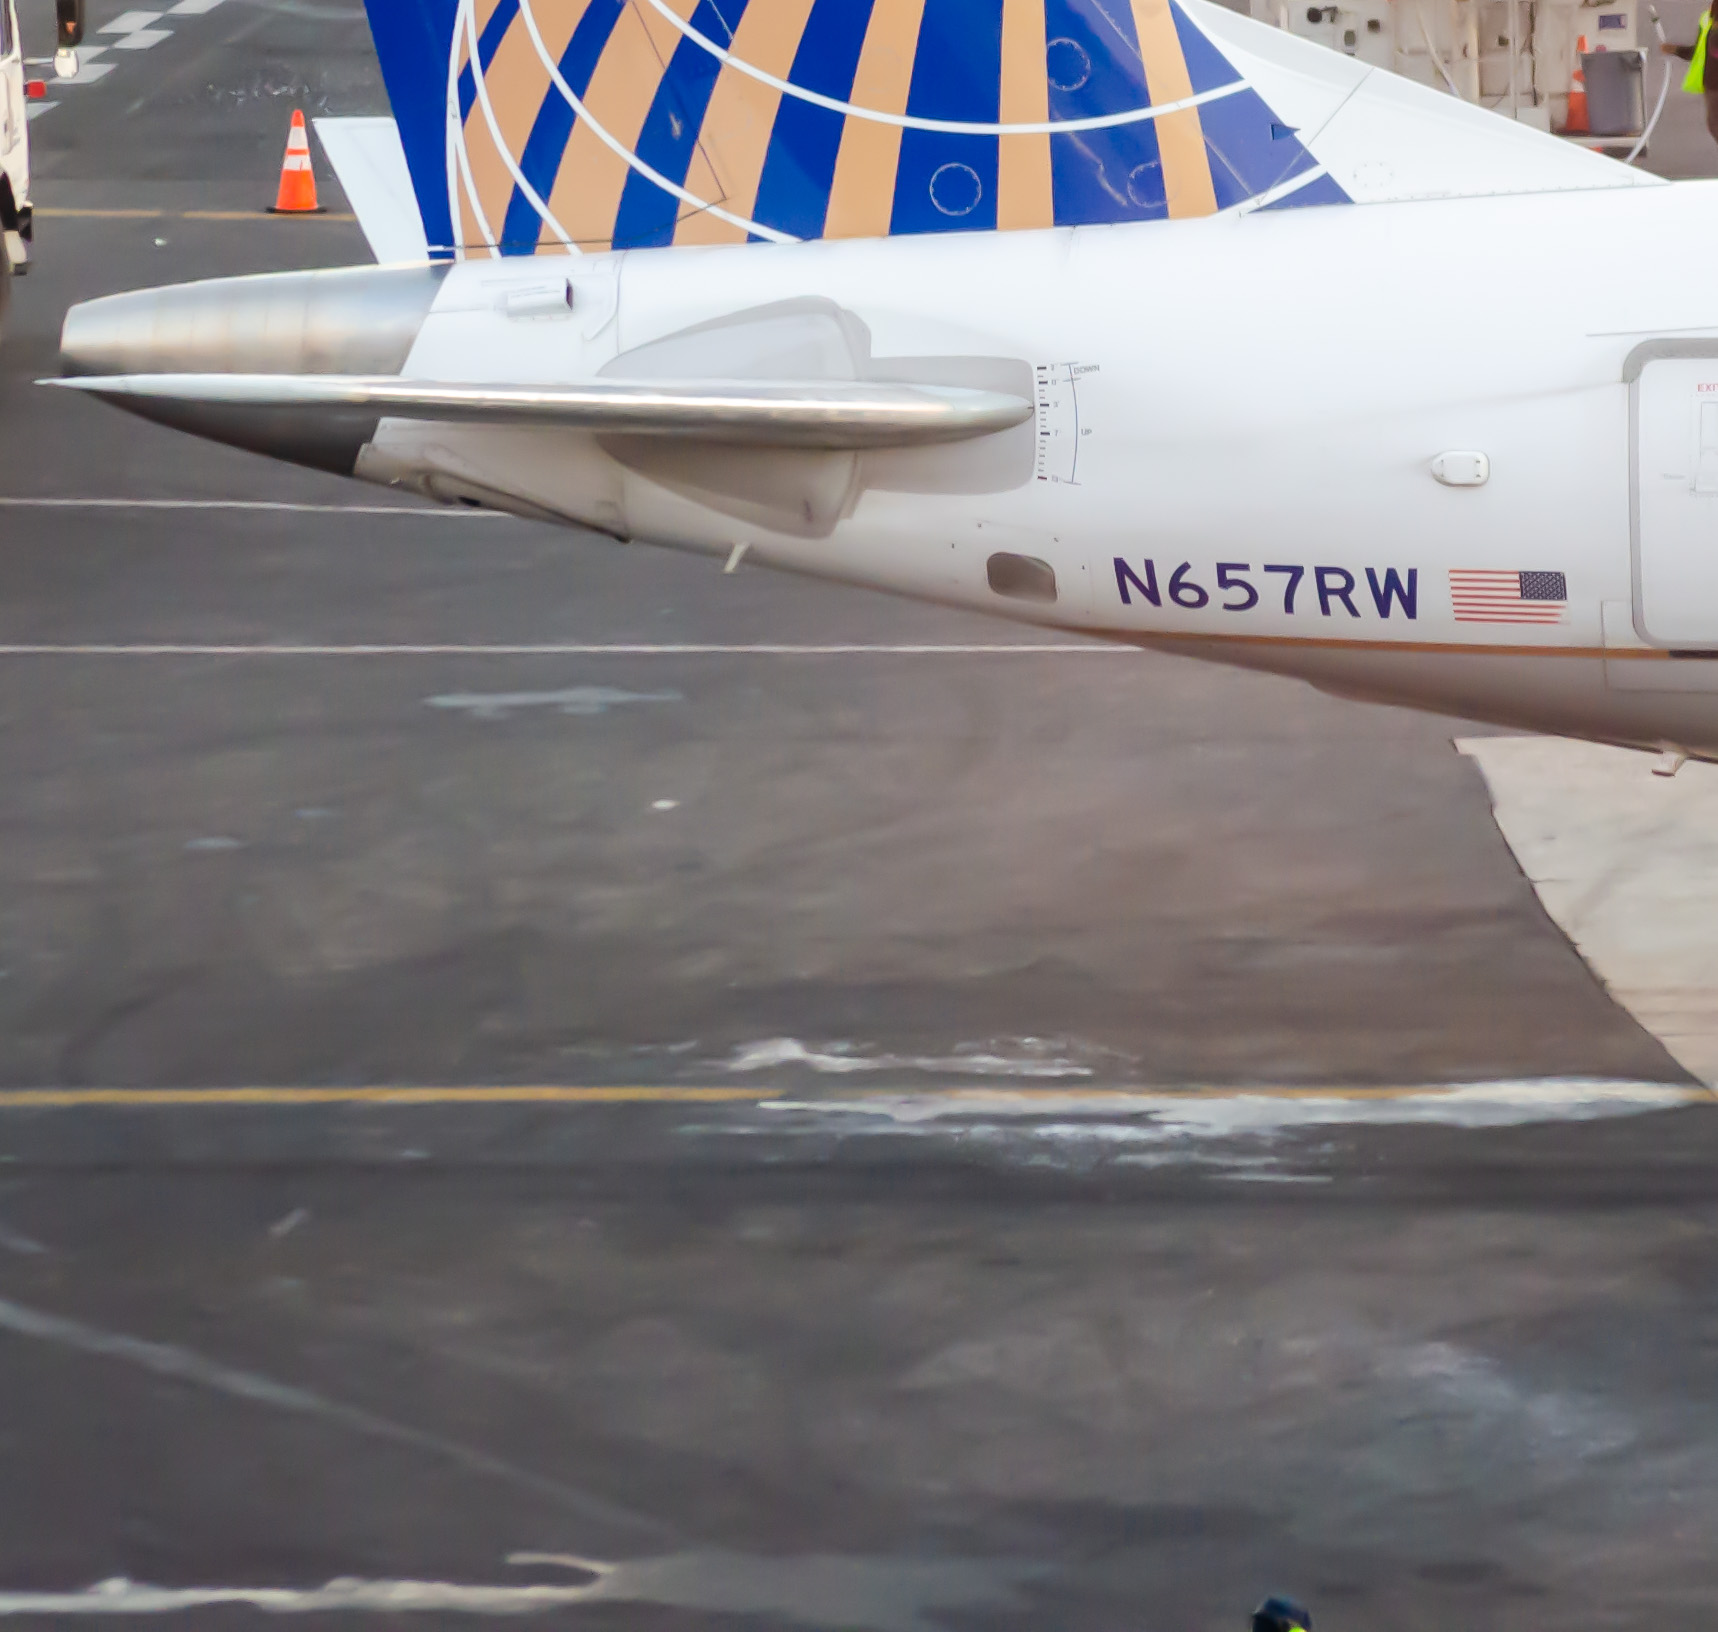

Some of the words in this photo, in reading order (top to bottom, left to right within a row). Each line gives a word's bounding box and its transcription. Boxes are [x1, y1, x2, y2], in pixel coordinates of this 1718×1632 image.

[1073, 364, 1100, 375] DOWN
[1080, 428, 1093, 436] UP
[1113, 557, 1418, 620] N657RW
